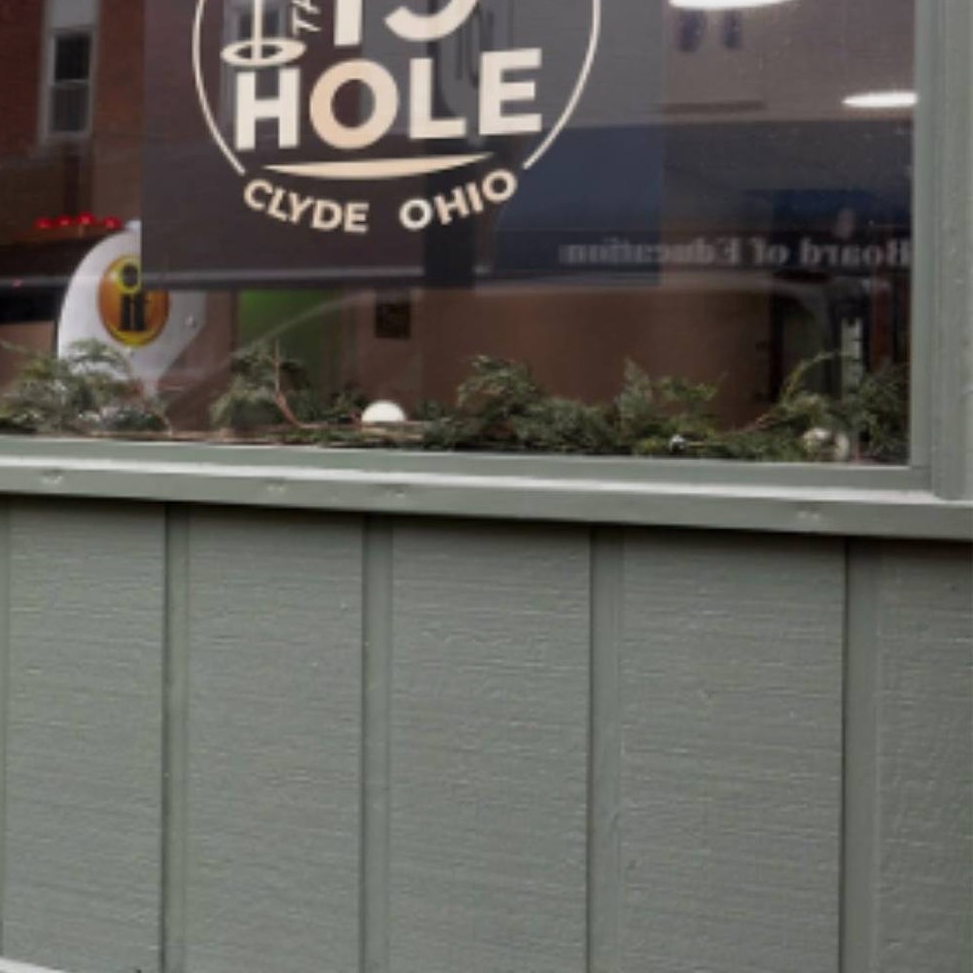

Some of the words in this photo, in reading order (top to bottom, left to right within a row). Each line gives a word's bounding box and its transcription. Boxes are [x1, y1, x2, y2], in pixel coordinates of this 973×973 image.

[235, 47, 543, 151] HOLE
[243, 179, 370, 234] CLYDE
[398, 168, 518, 231] OHIO
